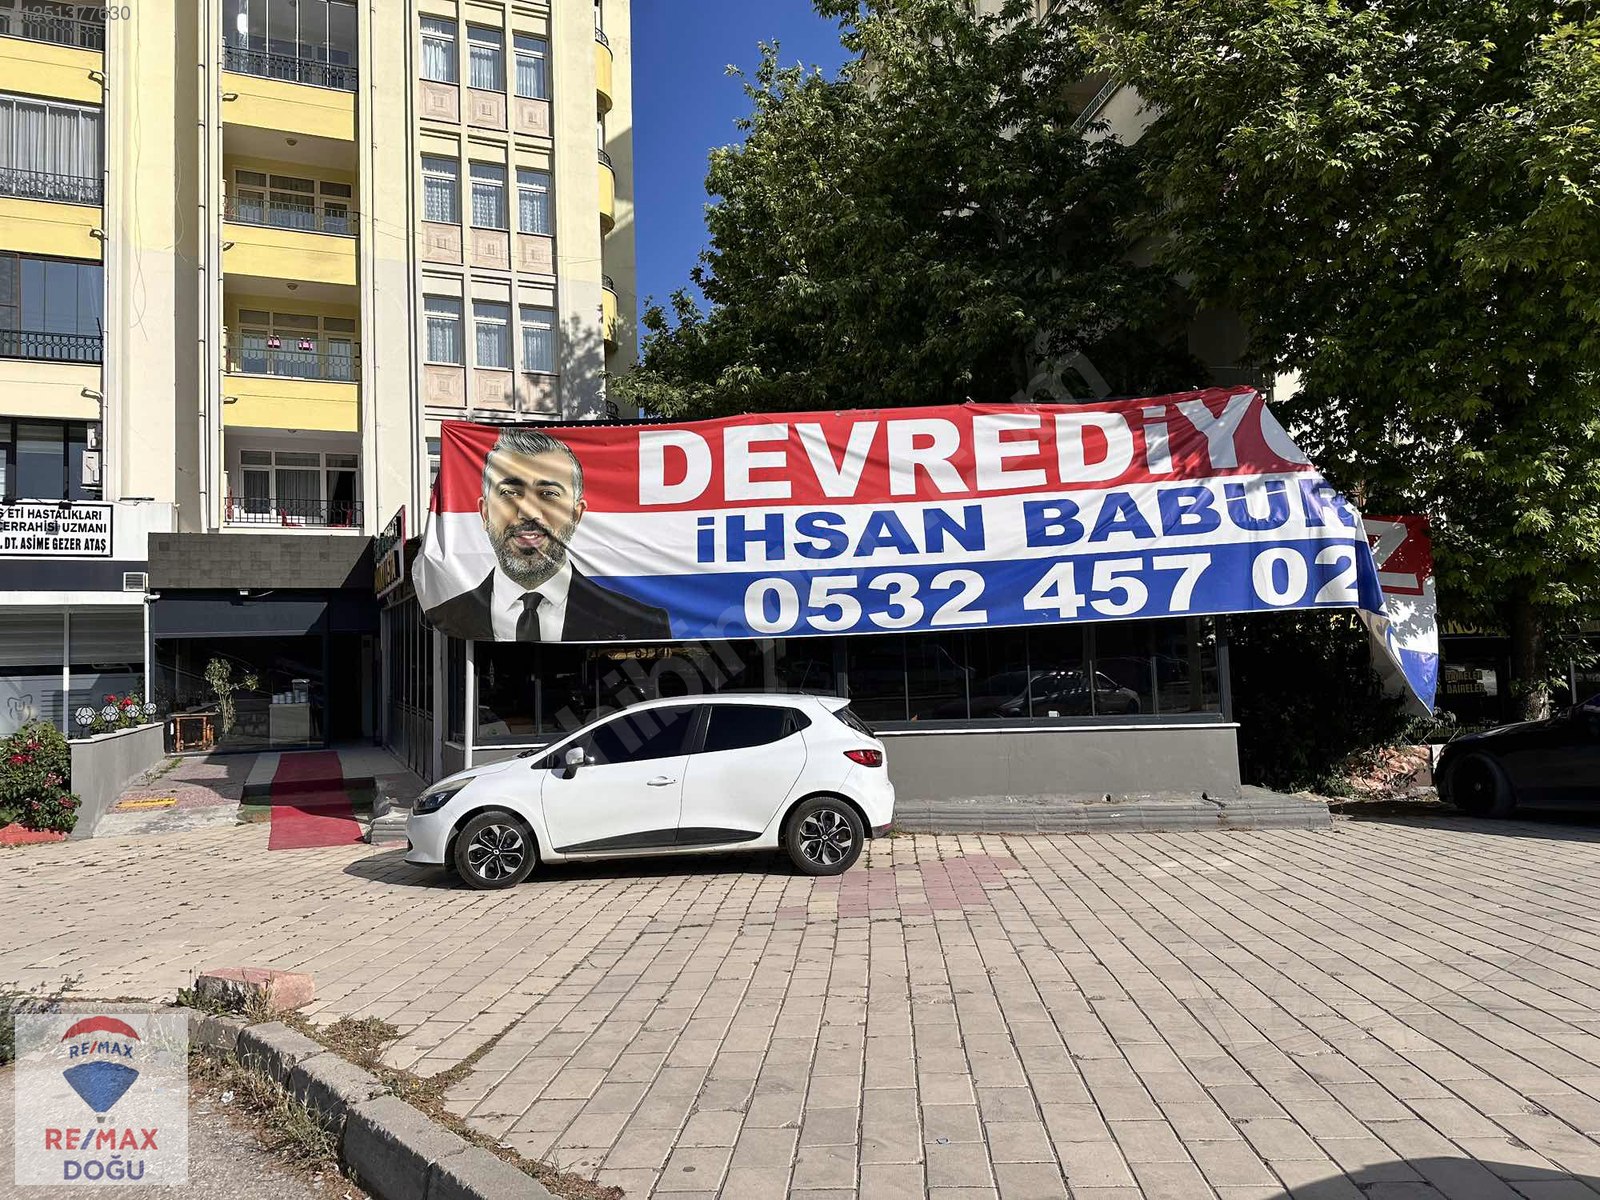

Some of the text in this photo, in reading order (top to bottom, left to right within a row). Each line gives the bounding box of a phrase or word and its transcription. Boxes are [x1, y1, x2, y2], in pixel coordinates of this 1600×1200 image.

[28, 509, 102, 520] HASTALIKLARI
[62, 523, 107, 533] UZMANI
[5, 534, 106, 553] DT. ASİME GEZER ATAŞ
[744, 545, 1359, 634] 0532 457 02
